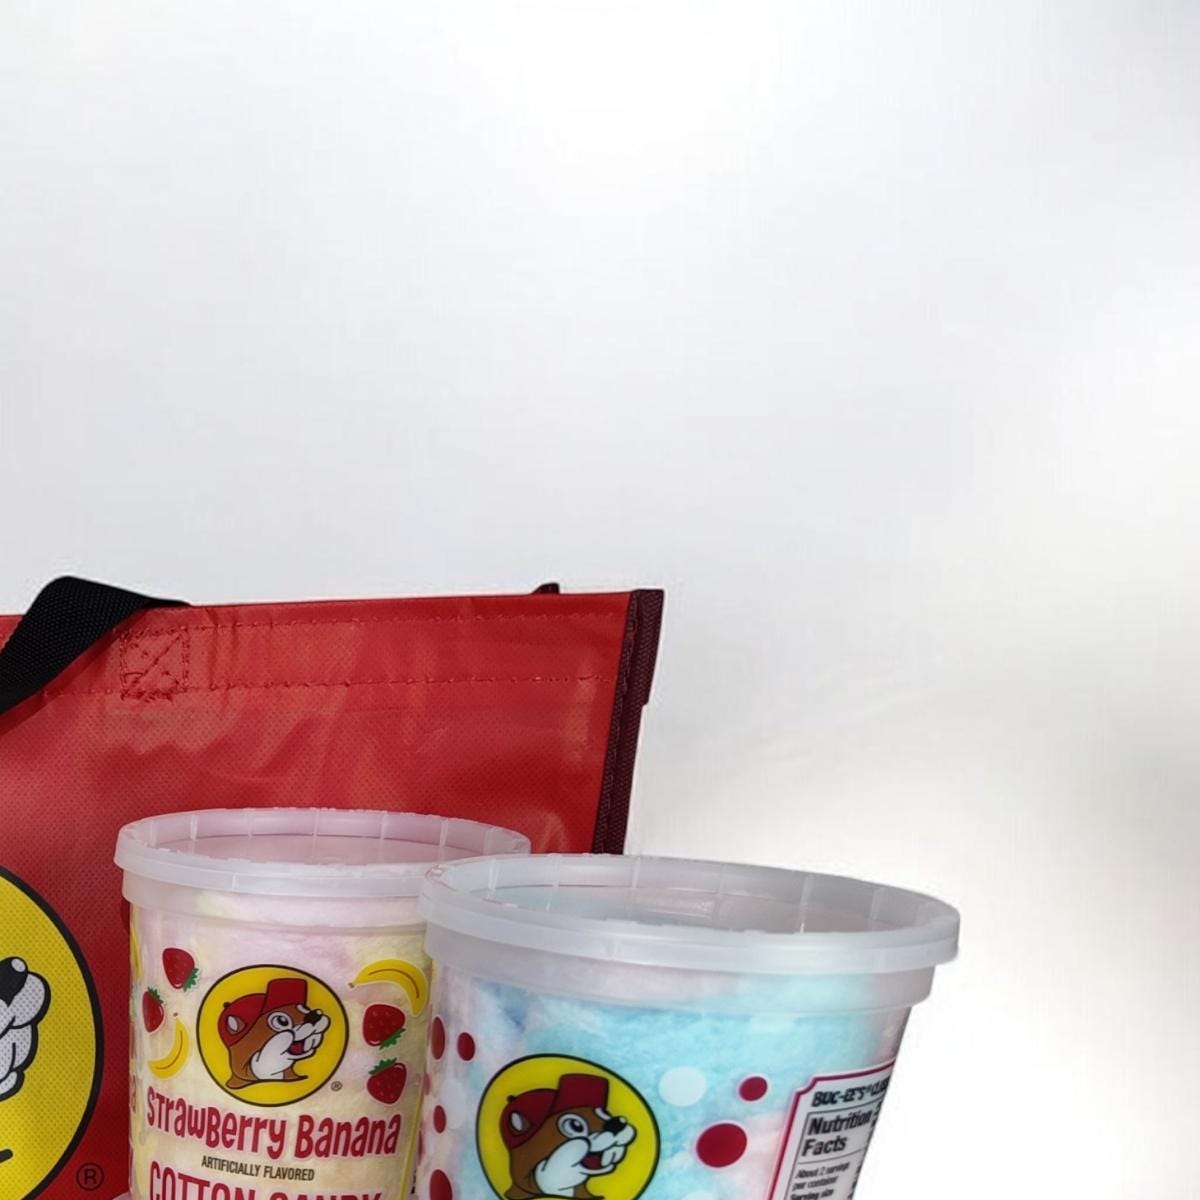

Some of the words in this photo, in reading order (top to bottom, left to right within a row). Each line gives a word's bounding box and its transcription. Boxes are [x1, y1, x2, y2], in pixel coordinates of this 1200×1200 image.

[807, 1109, 872, 1136] Nutrition
[294, 1113, 402, 1159] Banana
[801, 1135, 848, 1156] Facts
[201, 1156, 261, 1178] ARTIFICIALLY
[263, 1166, 315, 1181] FLAVORED
